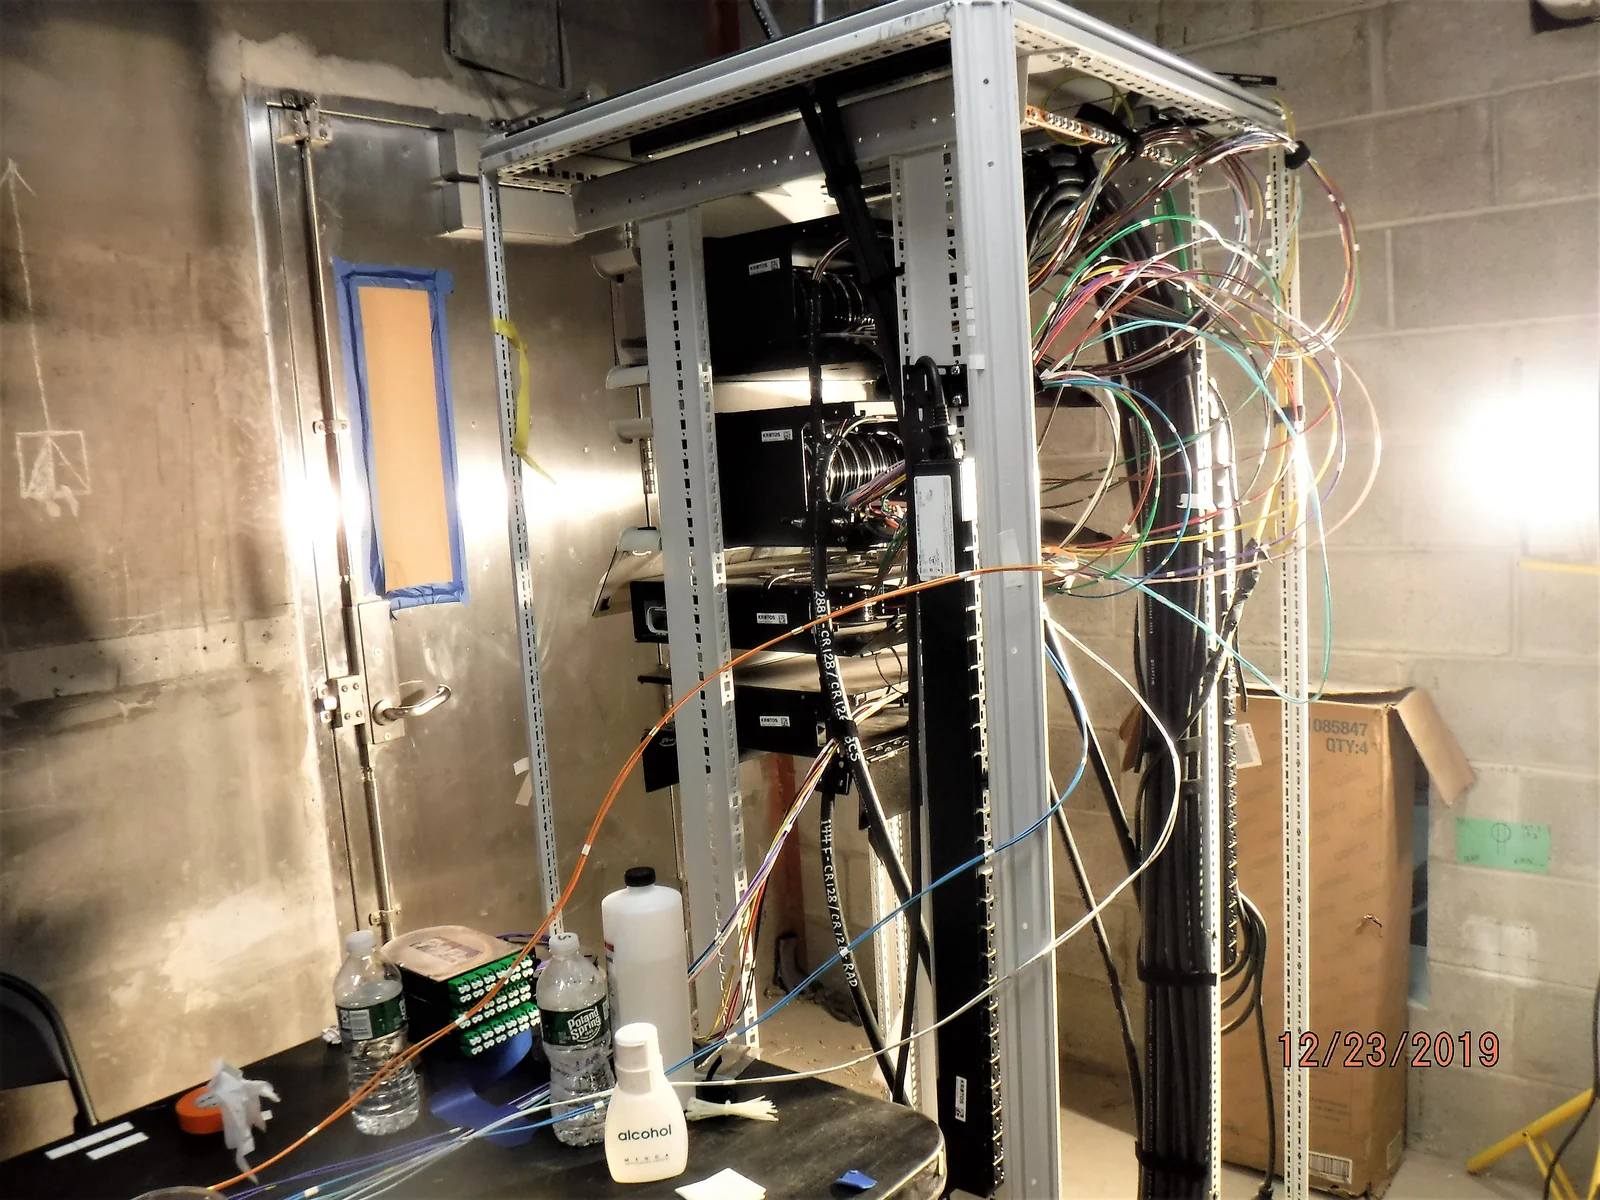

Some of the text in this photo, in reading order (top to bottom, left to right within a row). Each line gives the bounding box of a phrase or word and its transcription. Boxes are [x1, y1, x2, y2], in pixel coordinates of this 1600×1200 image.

[1326, 737, 1369, 755] QTY:4
[567, 1006, 599, 1031] Poland
[570, 1015, 602, 1041] Spring
[617, 1124, 672, 1141] alcohol
